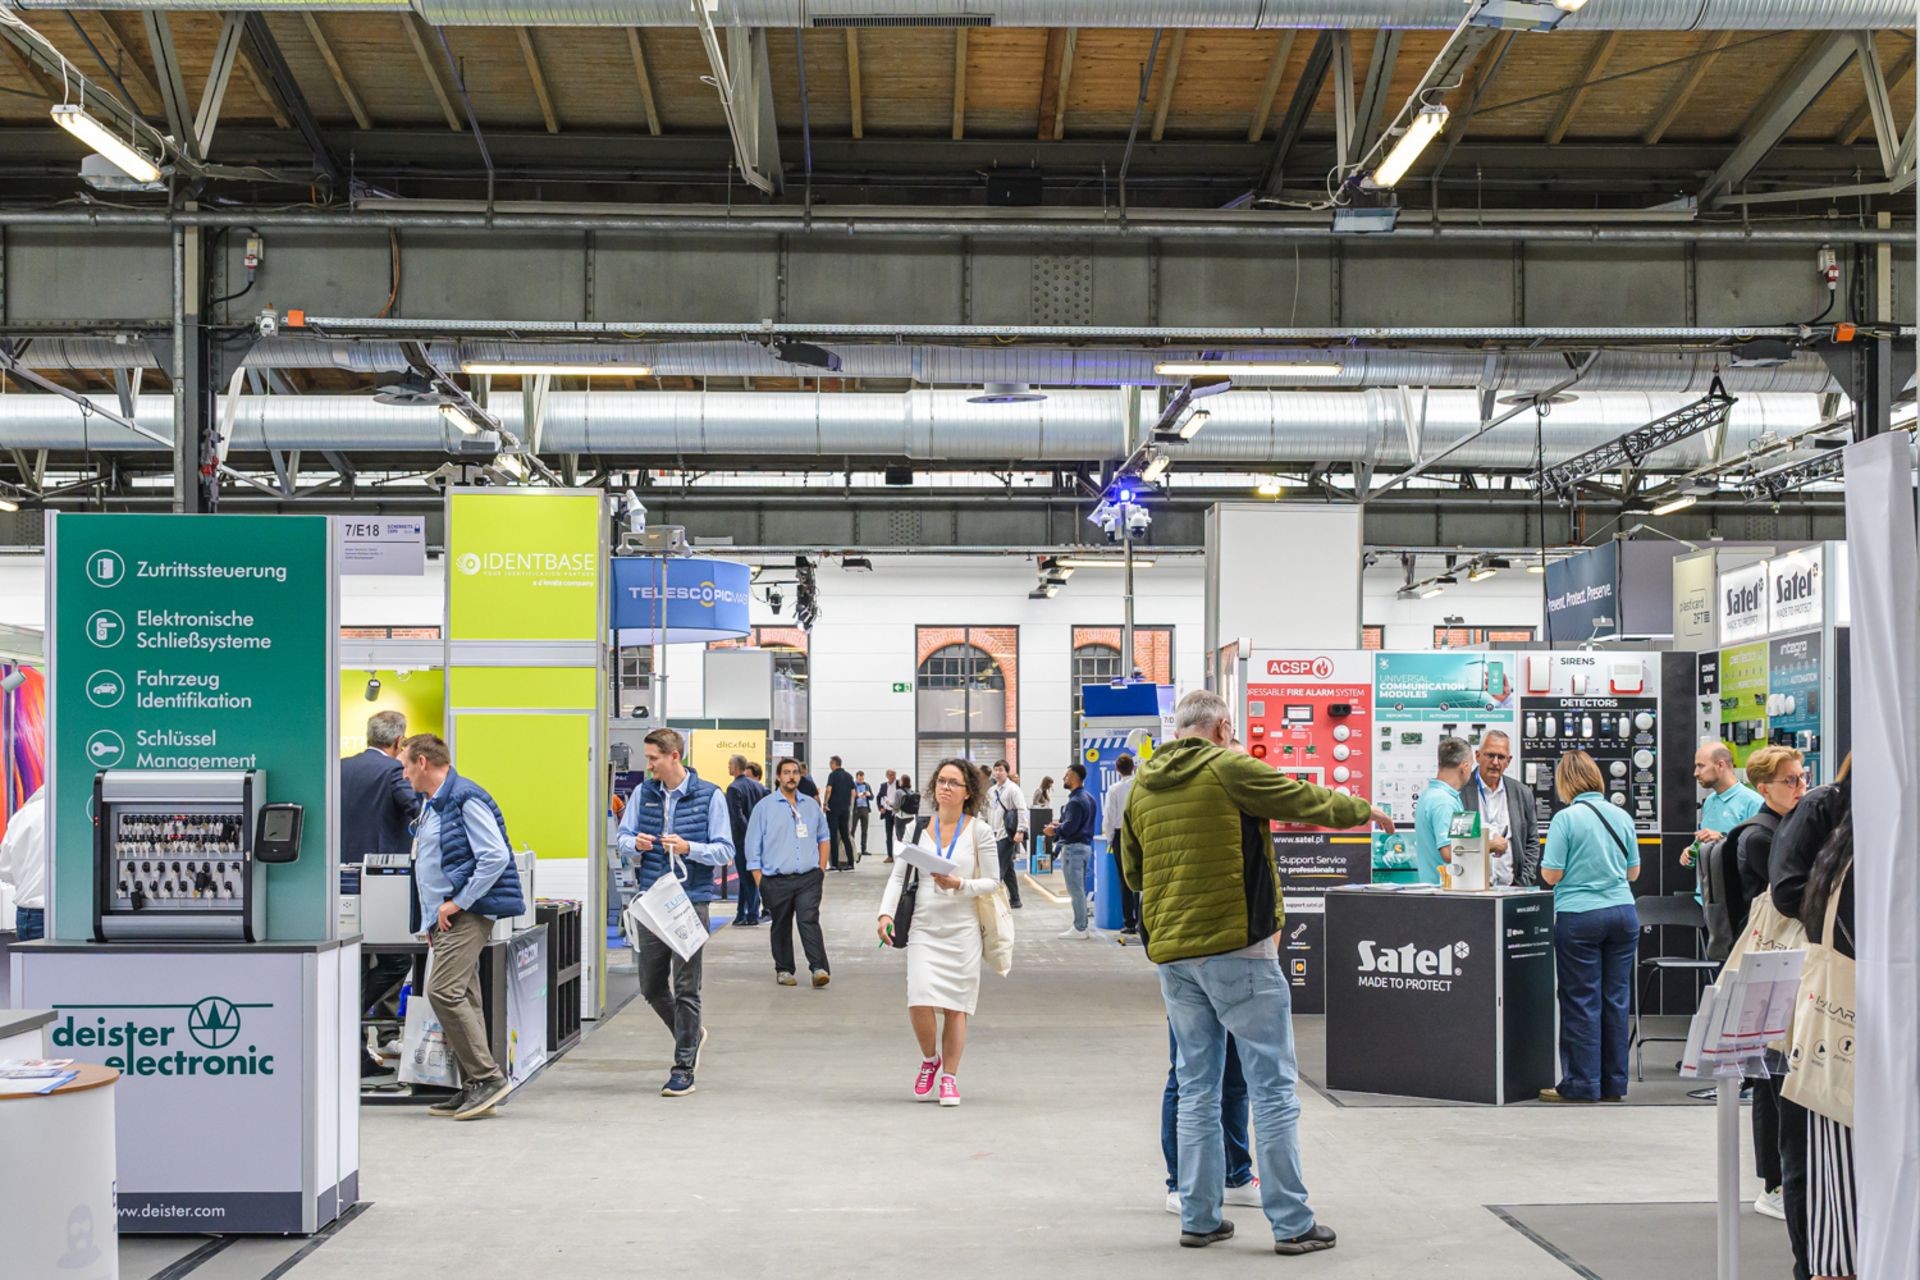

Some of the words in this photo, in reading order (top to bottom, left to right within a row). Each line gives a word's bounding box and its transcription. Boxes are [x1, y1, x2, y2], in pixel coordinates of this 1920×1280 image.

[345, 524, 380, 537] 7/E18
[483, 553, 594, 570] IDENTBASE
[136, 560, 287, 582] Zutrittssteuerung
[1776, 568, 1813, 603] Satel
[1726, 582, 1759, 616] Satel
[136, 609, 254, 627] Elektronische
[136, 631, 271, 652] Schließsysteme
[1270, 662, 1310, 673] ACSP
[1560, 657, 1595, 665] SIRENS
[136, 670, 220, 690] Fahrzeug
[1379, 674, 1430, 682] UNIVERSAL
[1287, 688, 1304, 696] FIRE
[1305, 688, 1334, 696] ALARM
[1335, 688, 1365, 697] SYSTEM
[1379, 683, 1465, 691] COMMUNICATION
[1379, 690, 1428, 698] MODULES
[136, 691, 252, 709] Identifikation
[1560, 698, 1618, 707] DETECTORS
[136, 729, 216, 747] Schlüssel
[136, 752, 256, 770] Management
[1273, 835, 1324, 845] www.satel.pl
[1280, 856, 1314, 865] Support
[1316, 855, 1347, 864] Service
[1288, 866, 1334, 874] professionals
[1357, 940, 1453, 976] Satel
[1358, 976, 1388, 988] MADE
[1389, 977, 1404, 989] TO
[1405, 978, 1452, 992] PROTECT
[52, 1016, 175, 1049] deister
[105, 1045, 274, 1076] electronic
[117, 1203, 225, 1218] ww.deister.com
